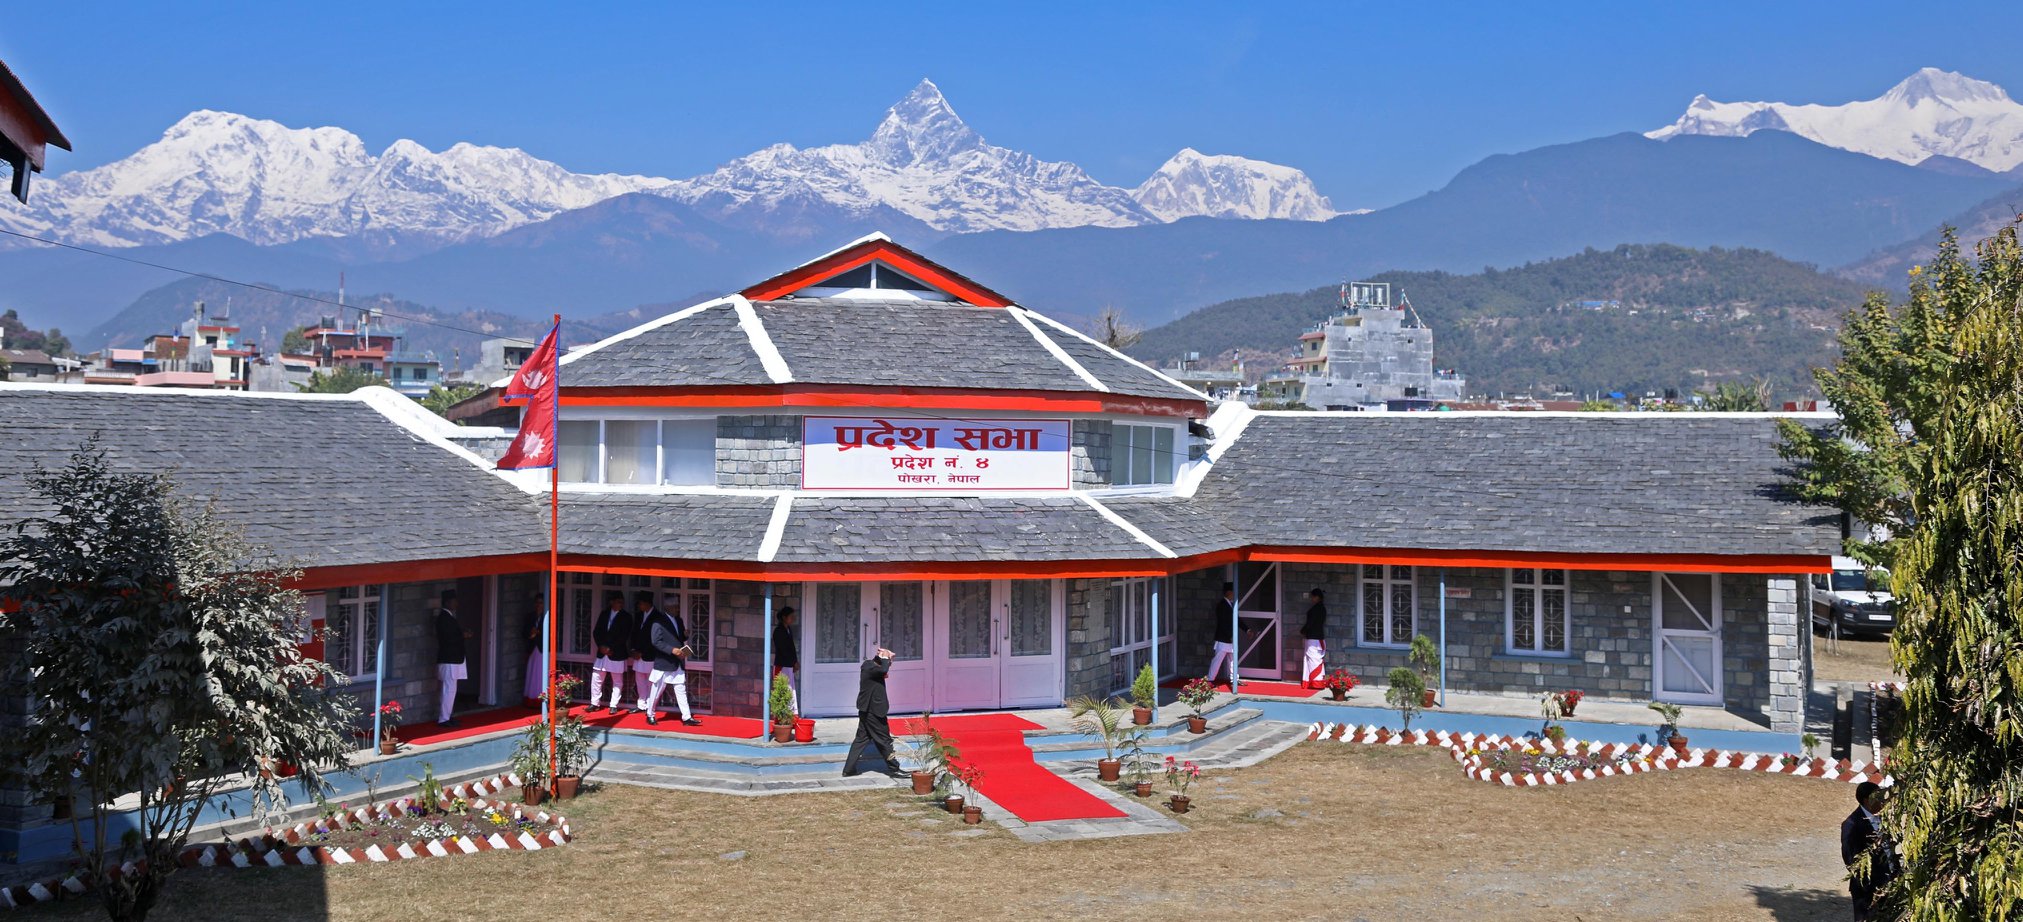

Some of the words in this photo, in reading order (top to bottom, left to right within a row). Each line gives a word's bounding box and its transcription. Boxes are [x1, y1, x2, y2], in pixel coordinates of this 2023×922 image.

[833, 420, 940, 451] प्रदेश
[953, 427, 1043, 451] सभा
[891, 454, 935, 470] प्रदेश
[976, 457, 989, 469] ४
[947, 473, 981, 484] नेपाल
